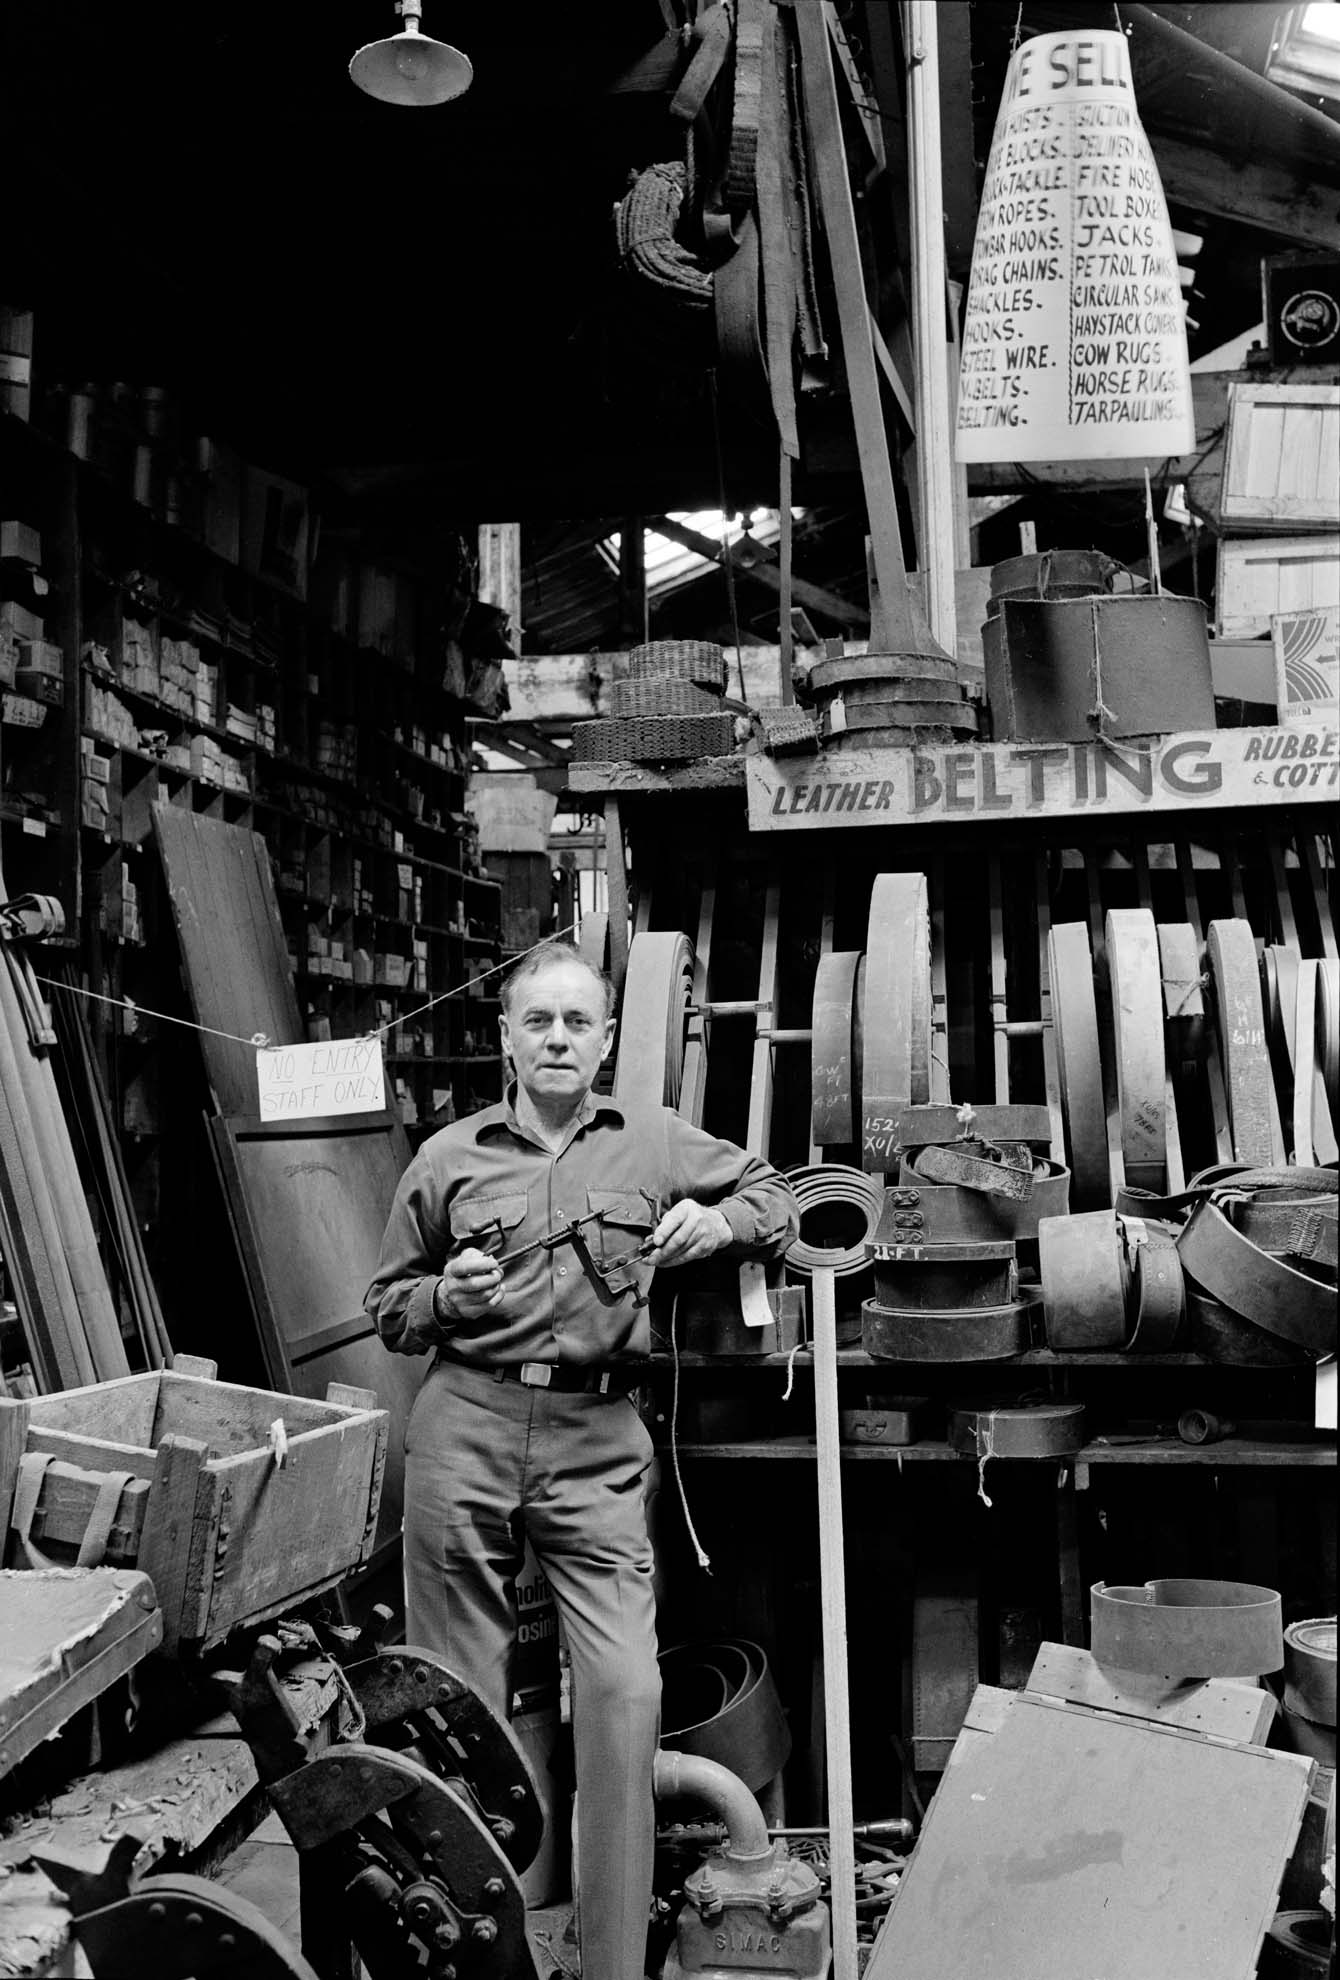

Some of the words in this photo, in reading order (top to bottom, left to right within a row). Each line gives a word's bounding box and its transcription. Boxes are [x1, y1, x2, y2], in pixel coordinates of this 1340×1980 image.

[1050, 42, 1127, 90] SELL
[1078, 164, 1120, 188] FIRE
[998, 197, 1056, 226] ROPES.
[1077, 195, 1119, 218] TOOL
[1009, 226, 1064, 255] HOOKS.
[1002, 257, 1064, 284] CHAINS.
[1075, 254, 1137, 278] PETROL
[1073, 284, 1140, 308] CIRCULAR
[1075, 312, 1141, 337] HAYSTACK
[961, 346, 997, 374] STEEL
[1005, 344, 1057, 371] WIRE.
[1073, 343, 1111, 367] COW
[1074, 369, 1132, 396] HORSE
[957, 403, 1028, 430] BELTING.
[1243, 731, 1338, 763] RUBBE
[772, 780, 895, 816] LEATHER
[908, 740, 1223, 815] BELTING
[1273, 760, 1338, 788] COTT
[272, 1053, 296, 1080] NO
[311, 1041, 377, 1076] ENTRY
[262, 1083, 325, 1114] STAFF
[518, 1614, 554, 1644] osin
